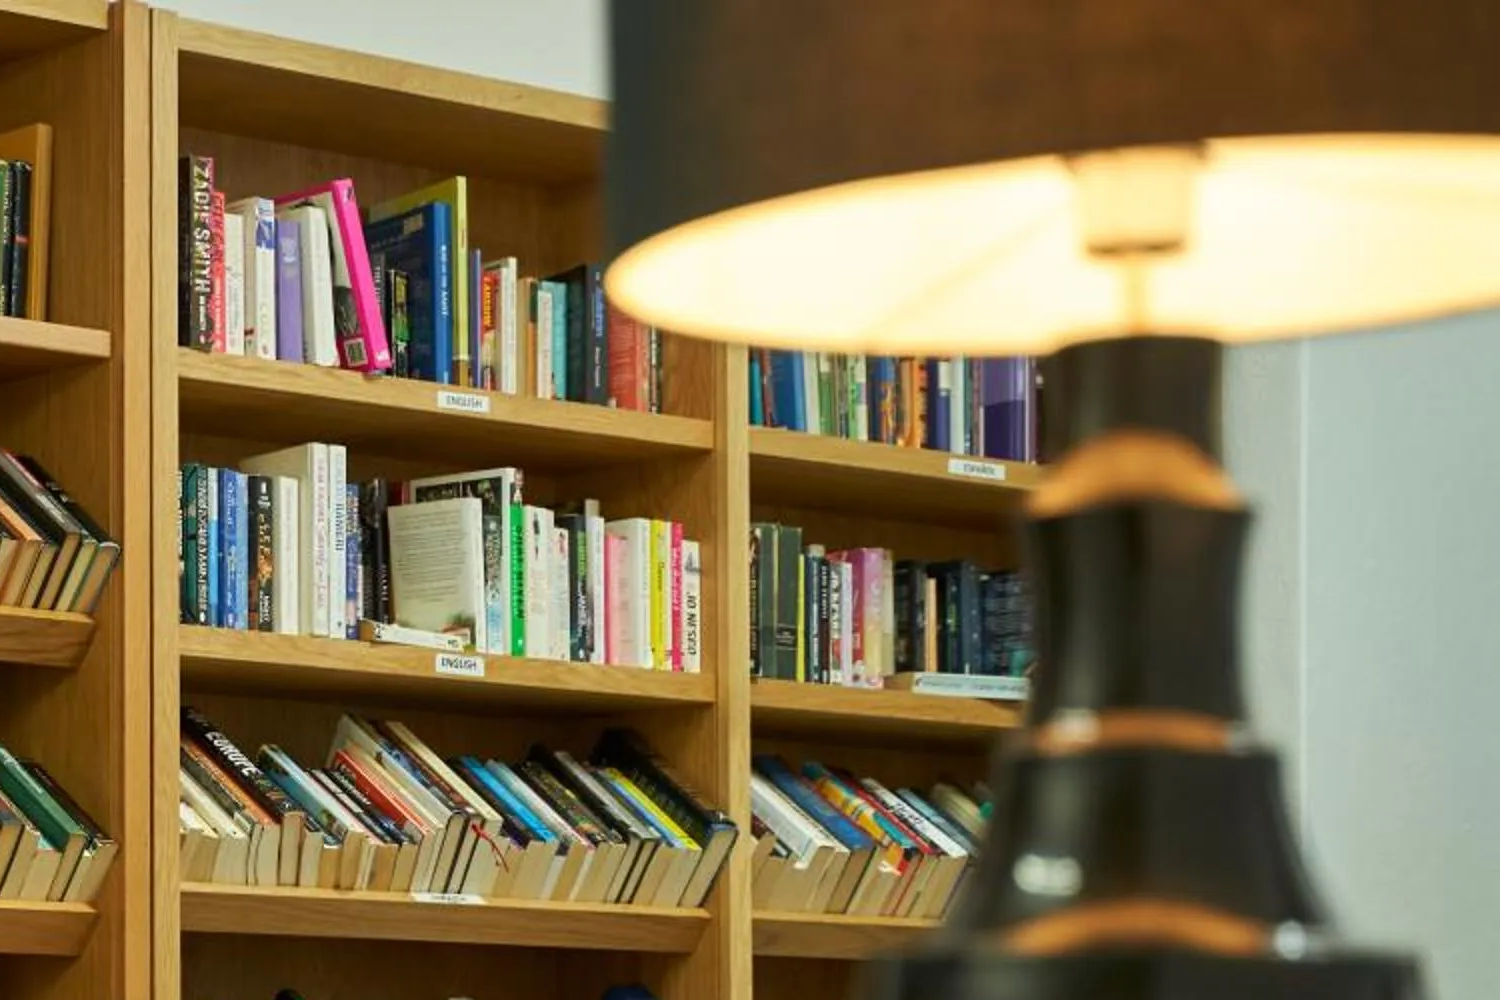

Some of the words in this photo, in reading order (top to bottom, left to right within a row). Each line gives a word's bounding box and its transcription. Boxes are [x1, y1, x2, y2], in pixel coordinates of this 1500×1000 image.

[194, 164, 211, 224] ZADIE
[194, 227, 211, 292] SMITH
[446, 395, 482, 409] ENGLISH
[441, 657, 477, 671] ENGLISH
